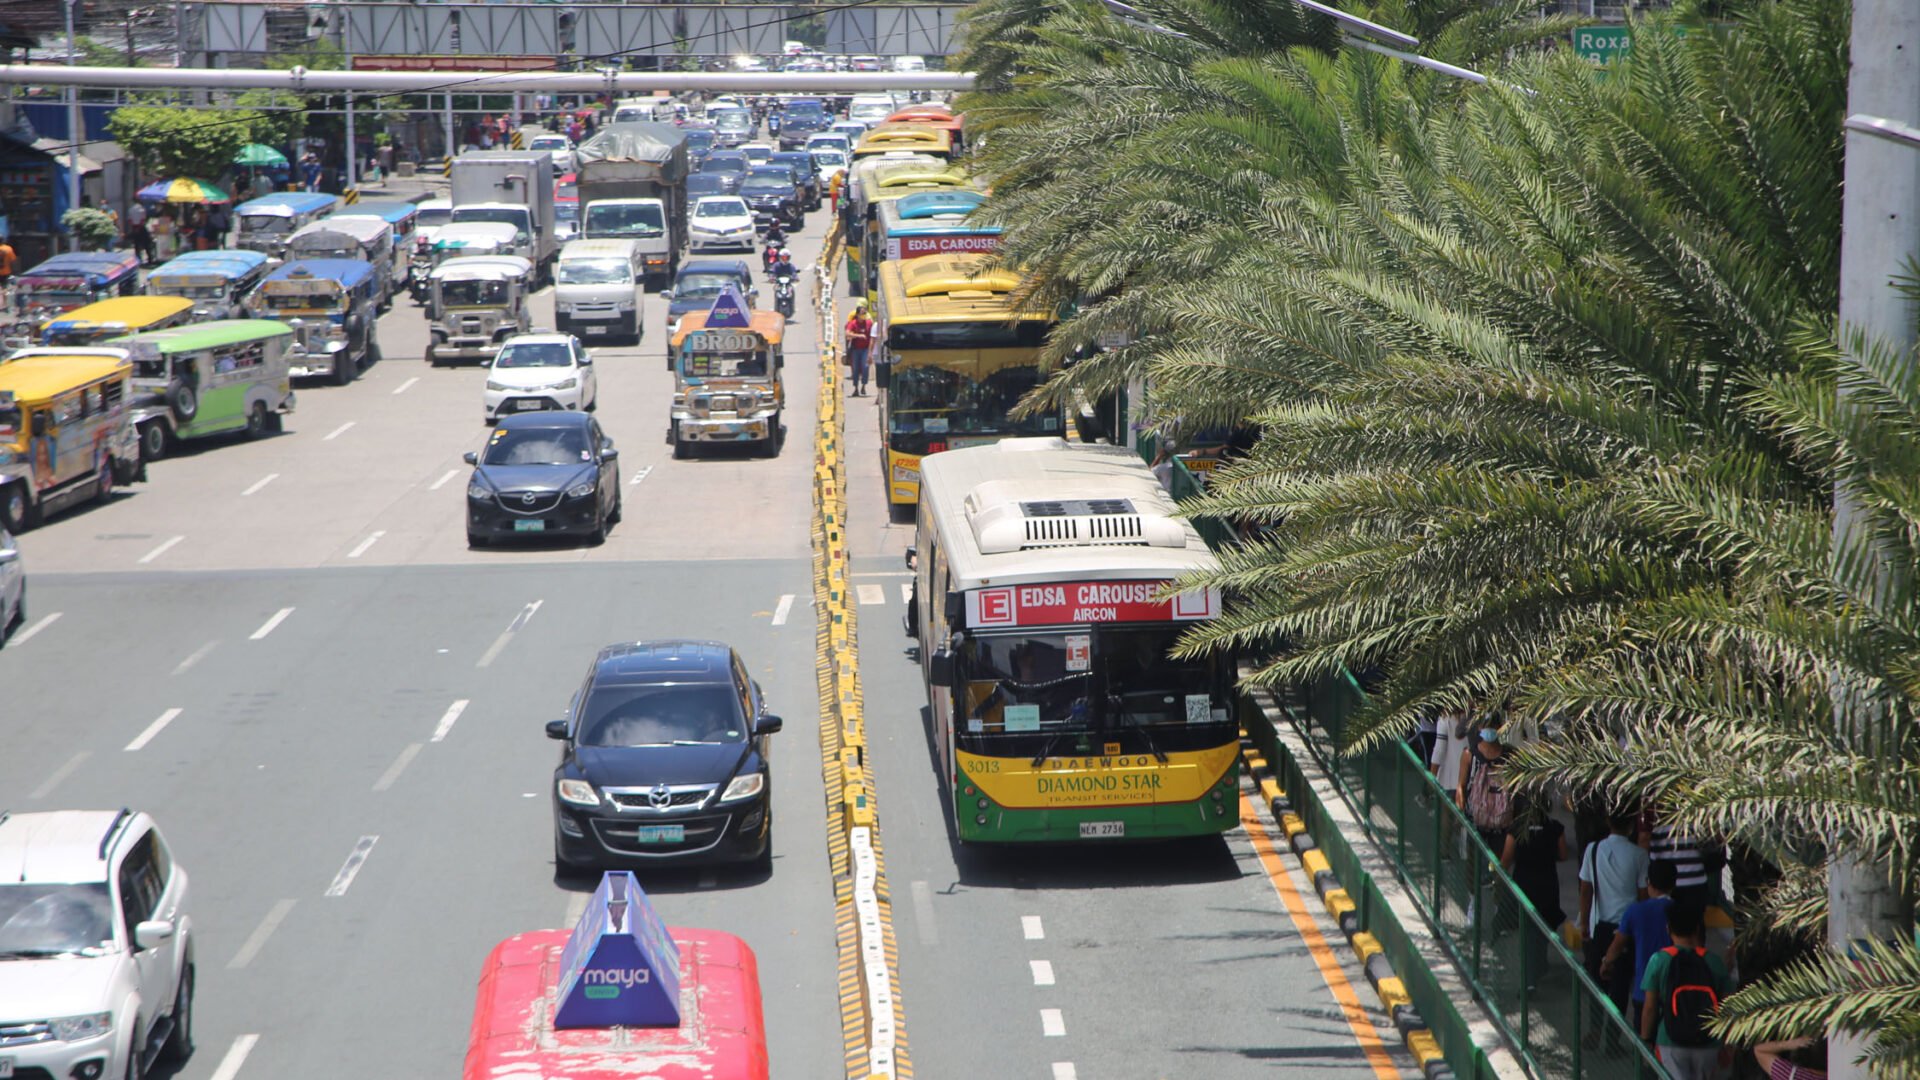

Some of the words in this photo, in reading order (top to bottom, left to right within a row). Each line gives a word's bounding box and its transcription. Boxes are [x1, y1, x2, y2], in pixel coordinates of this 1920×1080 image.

[1580, 33, 1630, 49] Roxa
[908, 240, 937, 250] EDSA
[714, 307, 738, 316] maya
[691, 334, 758, 350] BROD
[1190, 460, 1216, 469] CAUT
[1021, 587, 1066, 607] EDSA
[1078, 584, 1163, 606] CAROUSE
[1073, 607, 1117, 621] AIRCON
[967, 760, 1000, 774] 3013
[1052, 756, 1148, 769] DAEWOO
[1038, 775, 1117, 794] DIAMOND
[1122, 774, 1162, 789] STAR
[1101, 793, 1153, 801] SERVICES
[584, 967, 649, 989] maya
